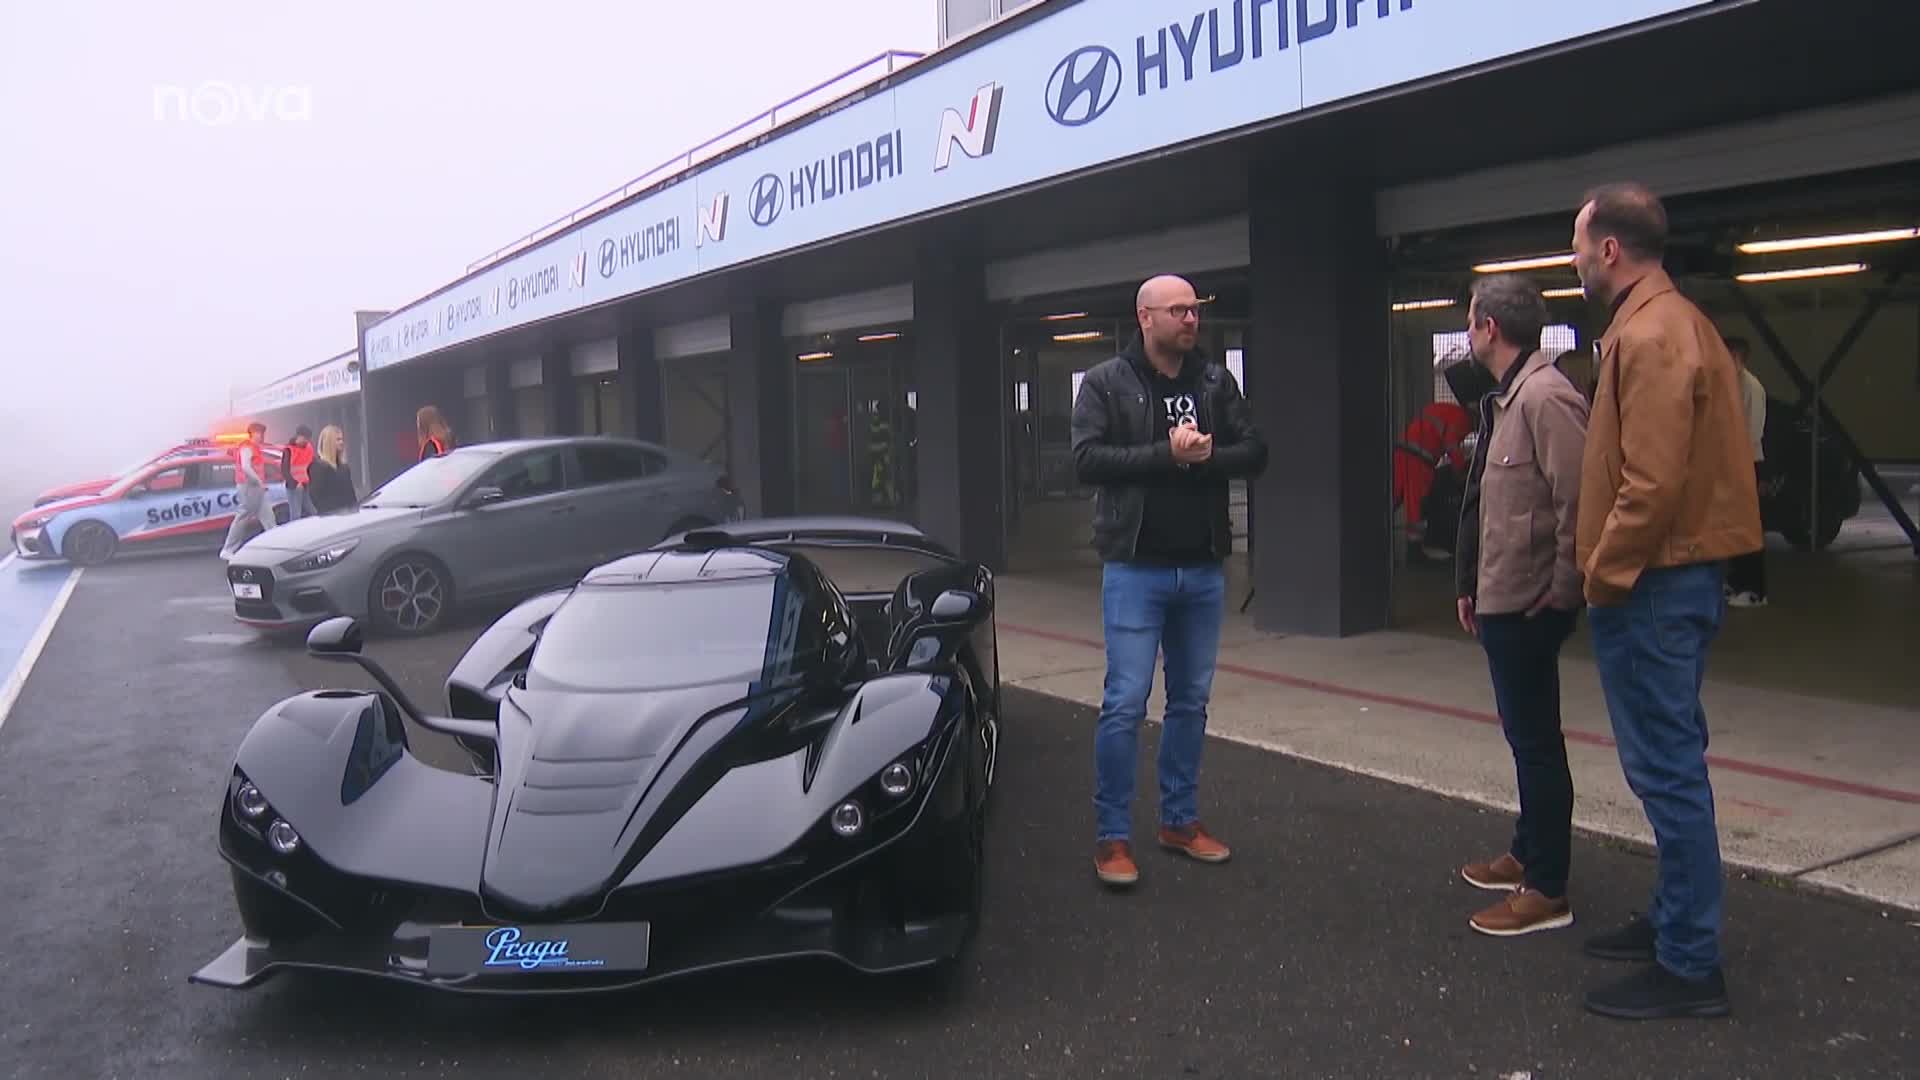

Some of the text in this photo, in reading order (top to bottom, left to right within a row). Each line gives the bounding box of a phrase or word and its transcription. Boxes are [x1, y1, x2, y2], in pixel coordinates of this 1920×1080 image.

[521, 264, 559, 303] HYUNDAI
[620, 216, 680, 268] HYUNDAI
[790, 128, 903, 211] HYUNDAI
[147, 499, 212, 524] Safety
[485, 927, 569, 969] Praga
